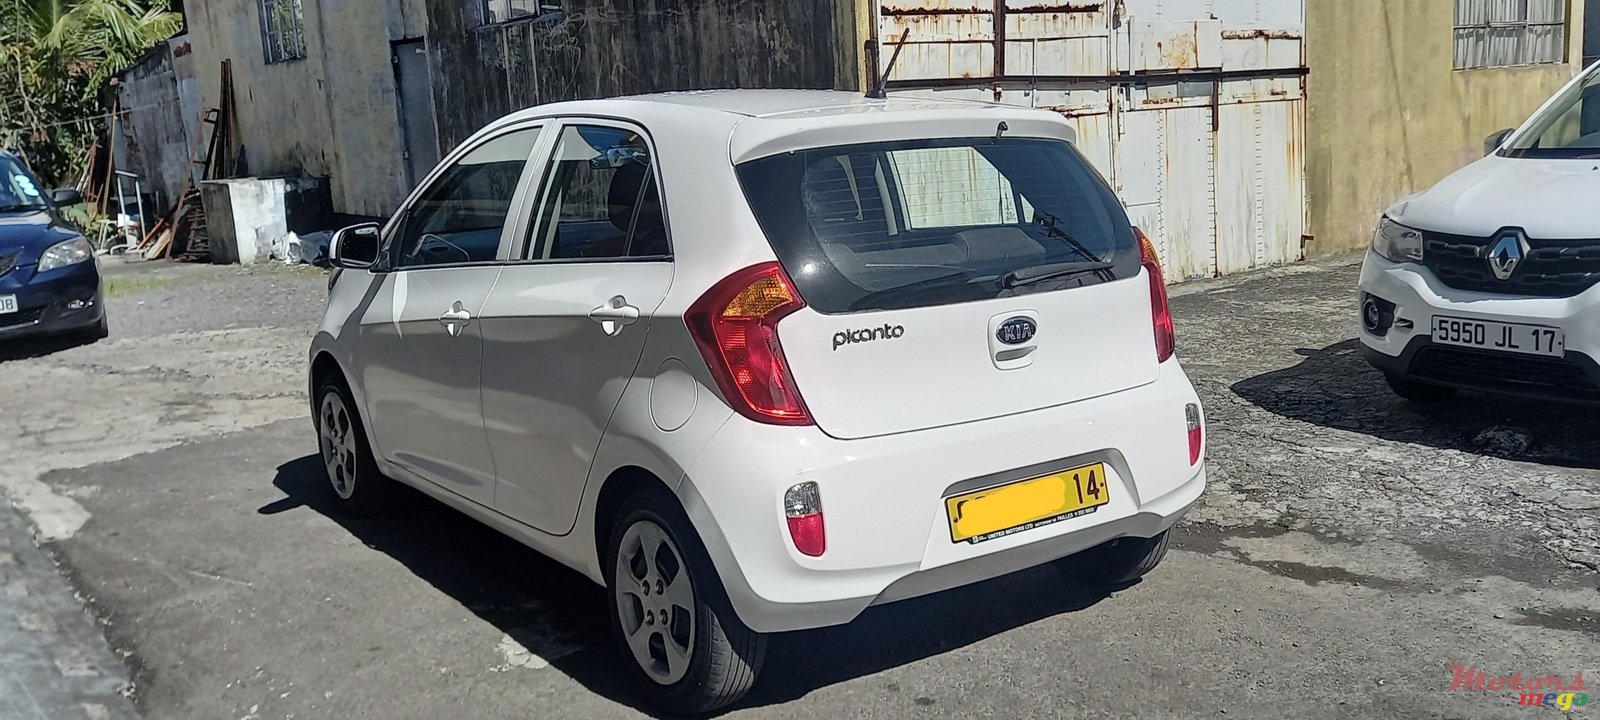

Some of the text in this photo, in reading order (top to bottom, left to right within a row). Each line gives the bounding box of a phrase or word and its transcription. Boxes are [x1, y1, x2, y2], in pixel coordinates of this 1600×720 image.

[832, 323, 905, 351] picanto
[1003, 322, 1032, 342] KIA
[1438, 319, 1556, 353] 5950 JL 17
[1072, 469, 1100, 504] 14
[987, 530, 1006, 540] UNITED
[1005, 525, 1025, 536] MOTORS
[1024, 523, 1034, 531] LTD
